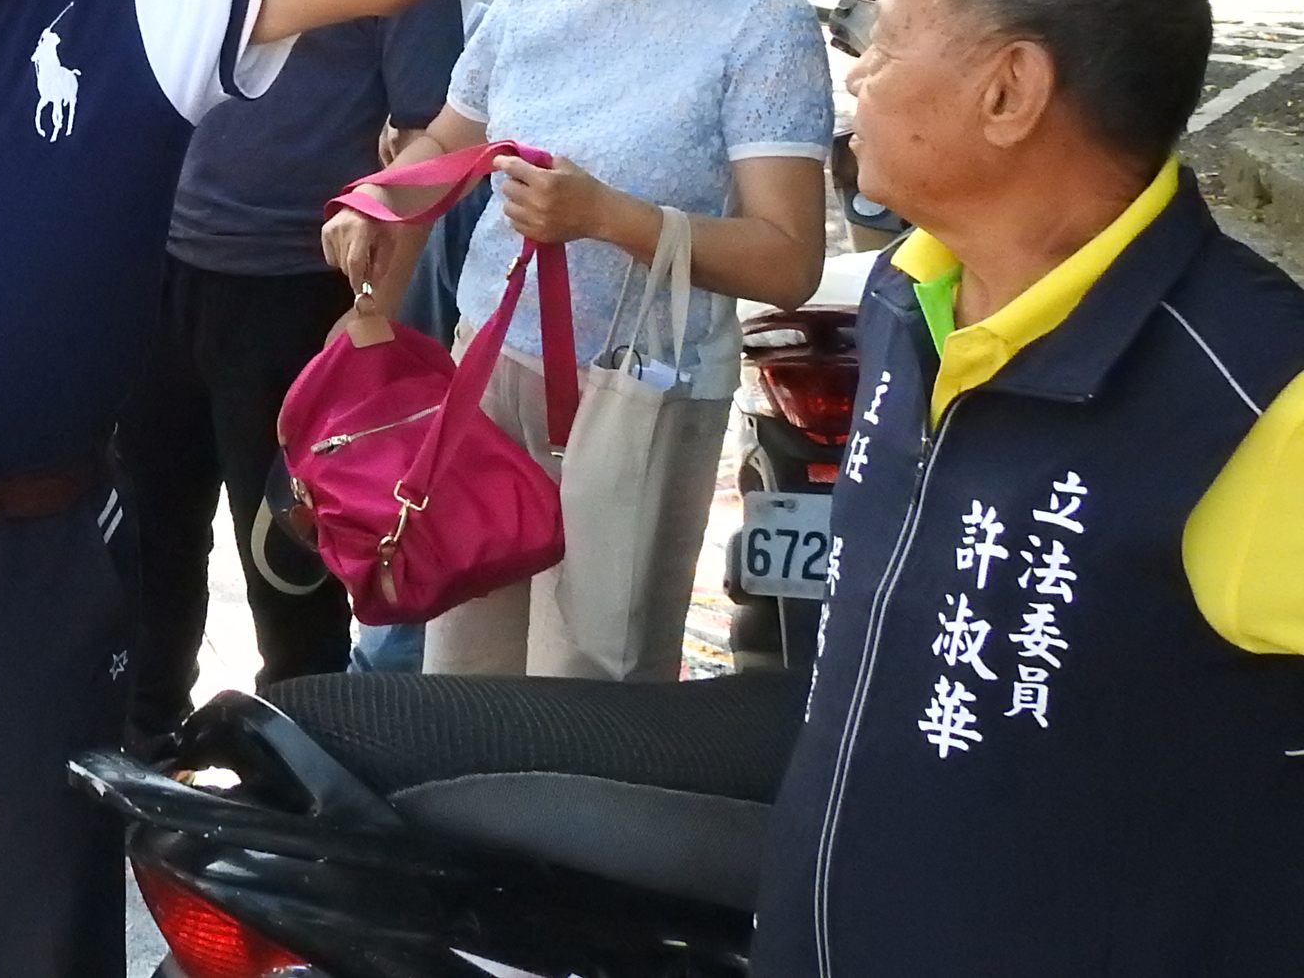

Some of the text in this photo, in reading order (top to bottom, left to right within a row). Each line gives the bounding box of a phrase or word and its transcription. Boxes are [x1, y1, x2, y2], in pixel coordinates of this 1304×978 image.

[917, 499, 1009, 759] 許淑華
[1003, 470, 1089, 728] 立法委員
